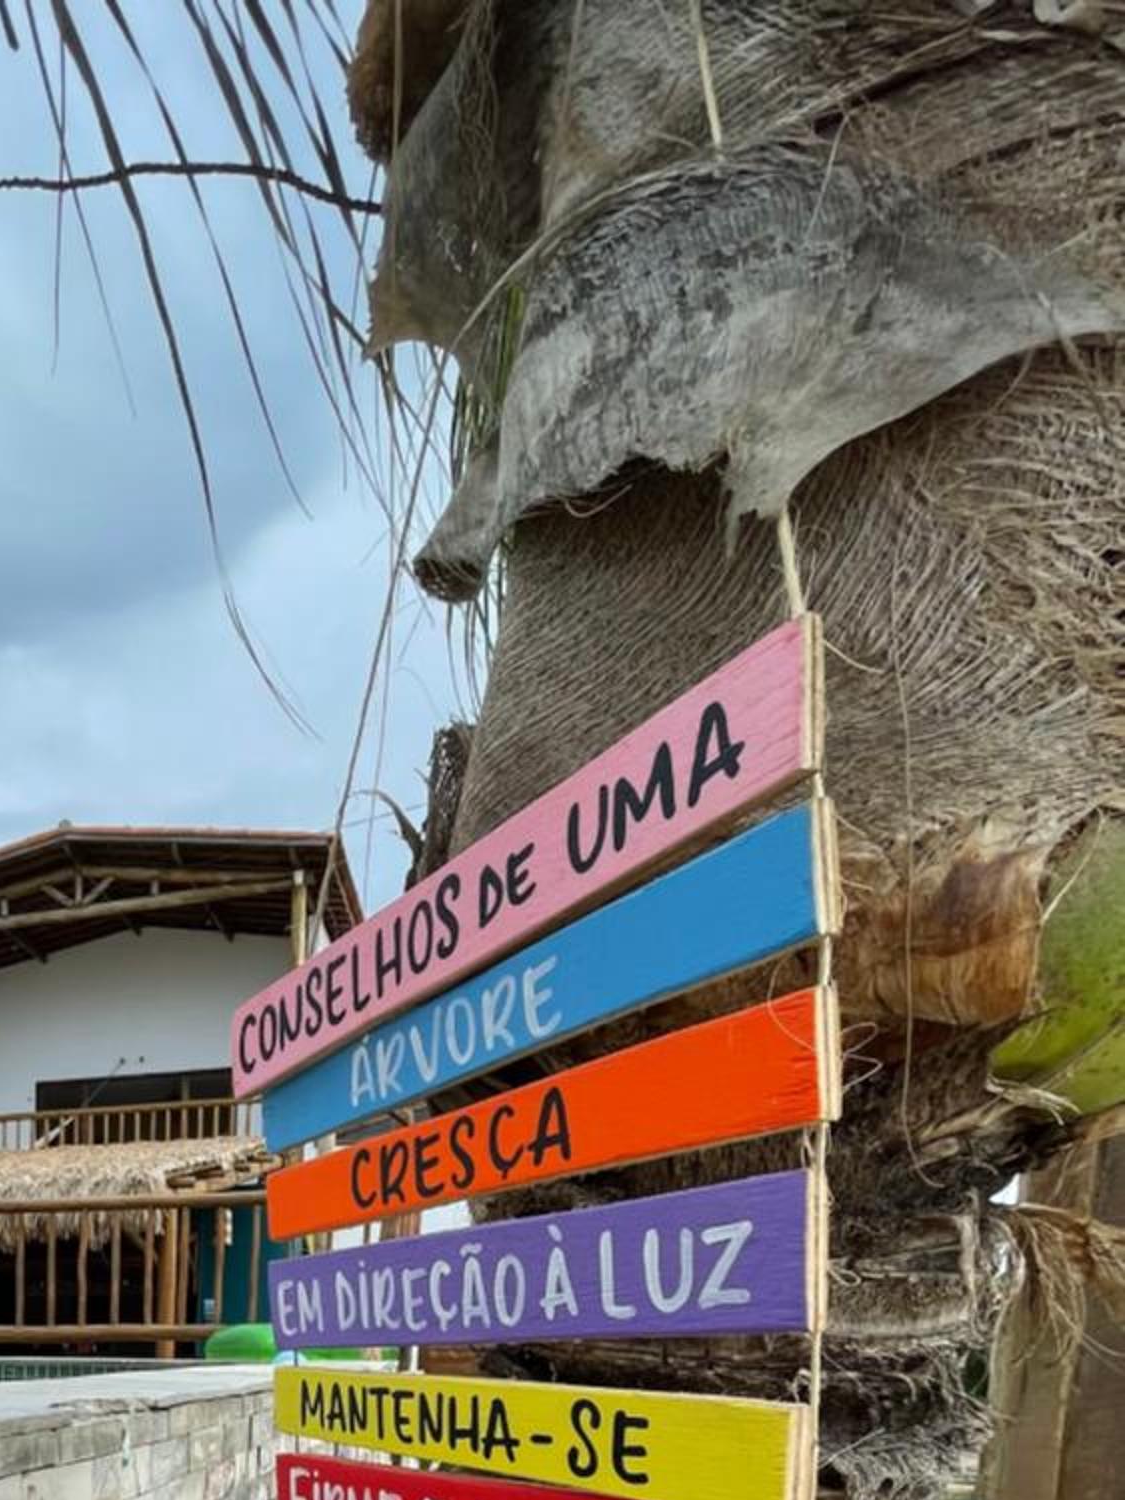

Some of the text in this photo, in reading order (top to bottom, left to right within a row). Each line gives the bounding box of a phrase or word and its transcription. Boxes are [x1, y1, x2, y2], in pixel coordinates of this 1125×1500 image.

[240, 701, 745, 1073] CONSELHOS DE UMA
[350, 956, 562, 1107] ÁRVORE
[350, 1087, 572, 1209] CRESÇA
[277, 1276, 324, 1336] EM
[540, 1224, 578, 1321] À
[599, 1221, 753, 1319] LUZ
[300, 1380, 649, 1484] MANTENHA-SE
